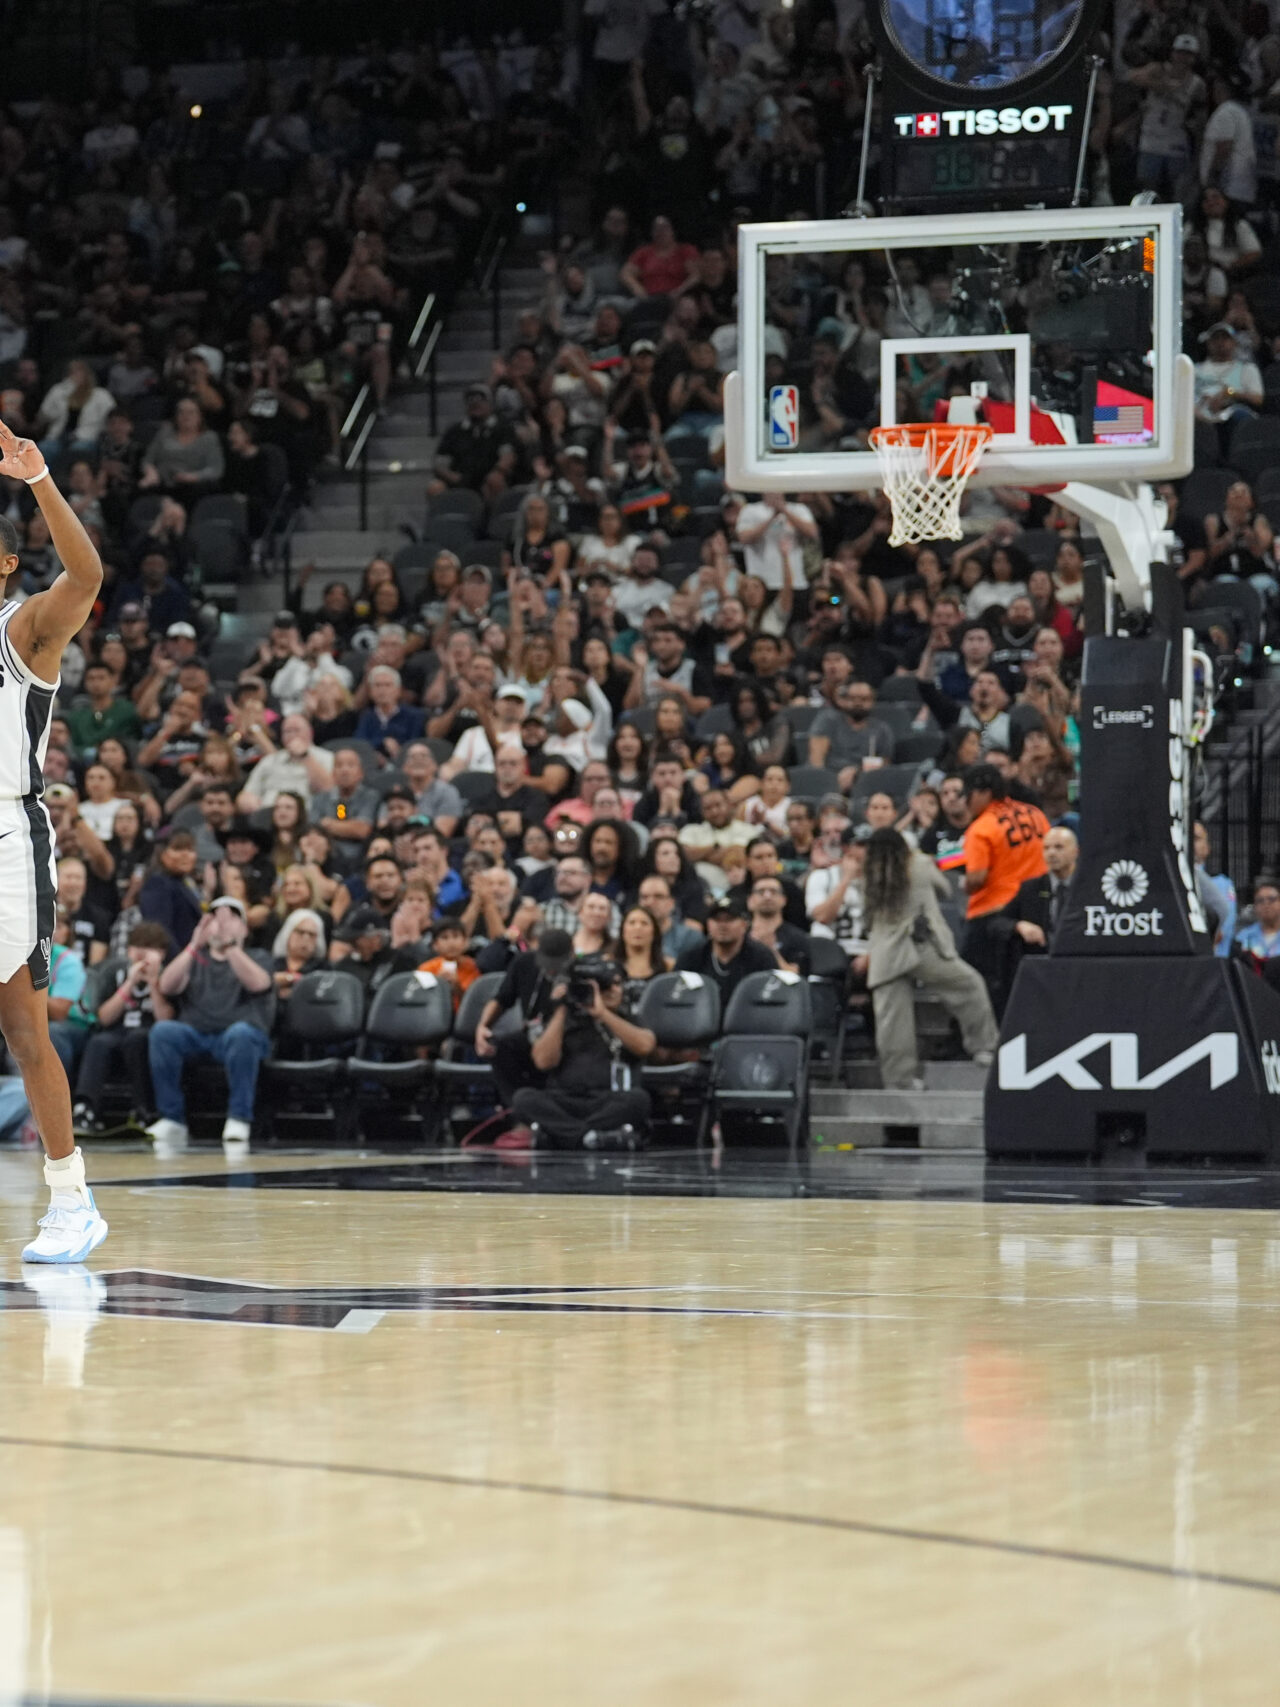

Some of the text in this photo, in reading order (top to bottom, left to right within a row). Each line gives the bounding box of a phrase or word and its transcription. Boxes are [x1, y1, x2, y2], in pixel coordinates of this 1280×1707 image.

[942, 105, 1073, 137] TISSOT
[1101, 711, 1146, 724] LEDGER
[1084, 906, 1164, 936] Frost
[998, 1032, 1239, 1091] KIA
